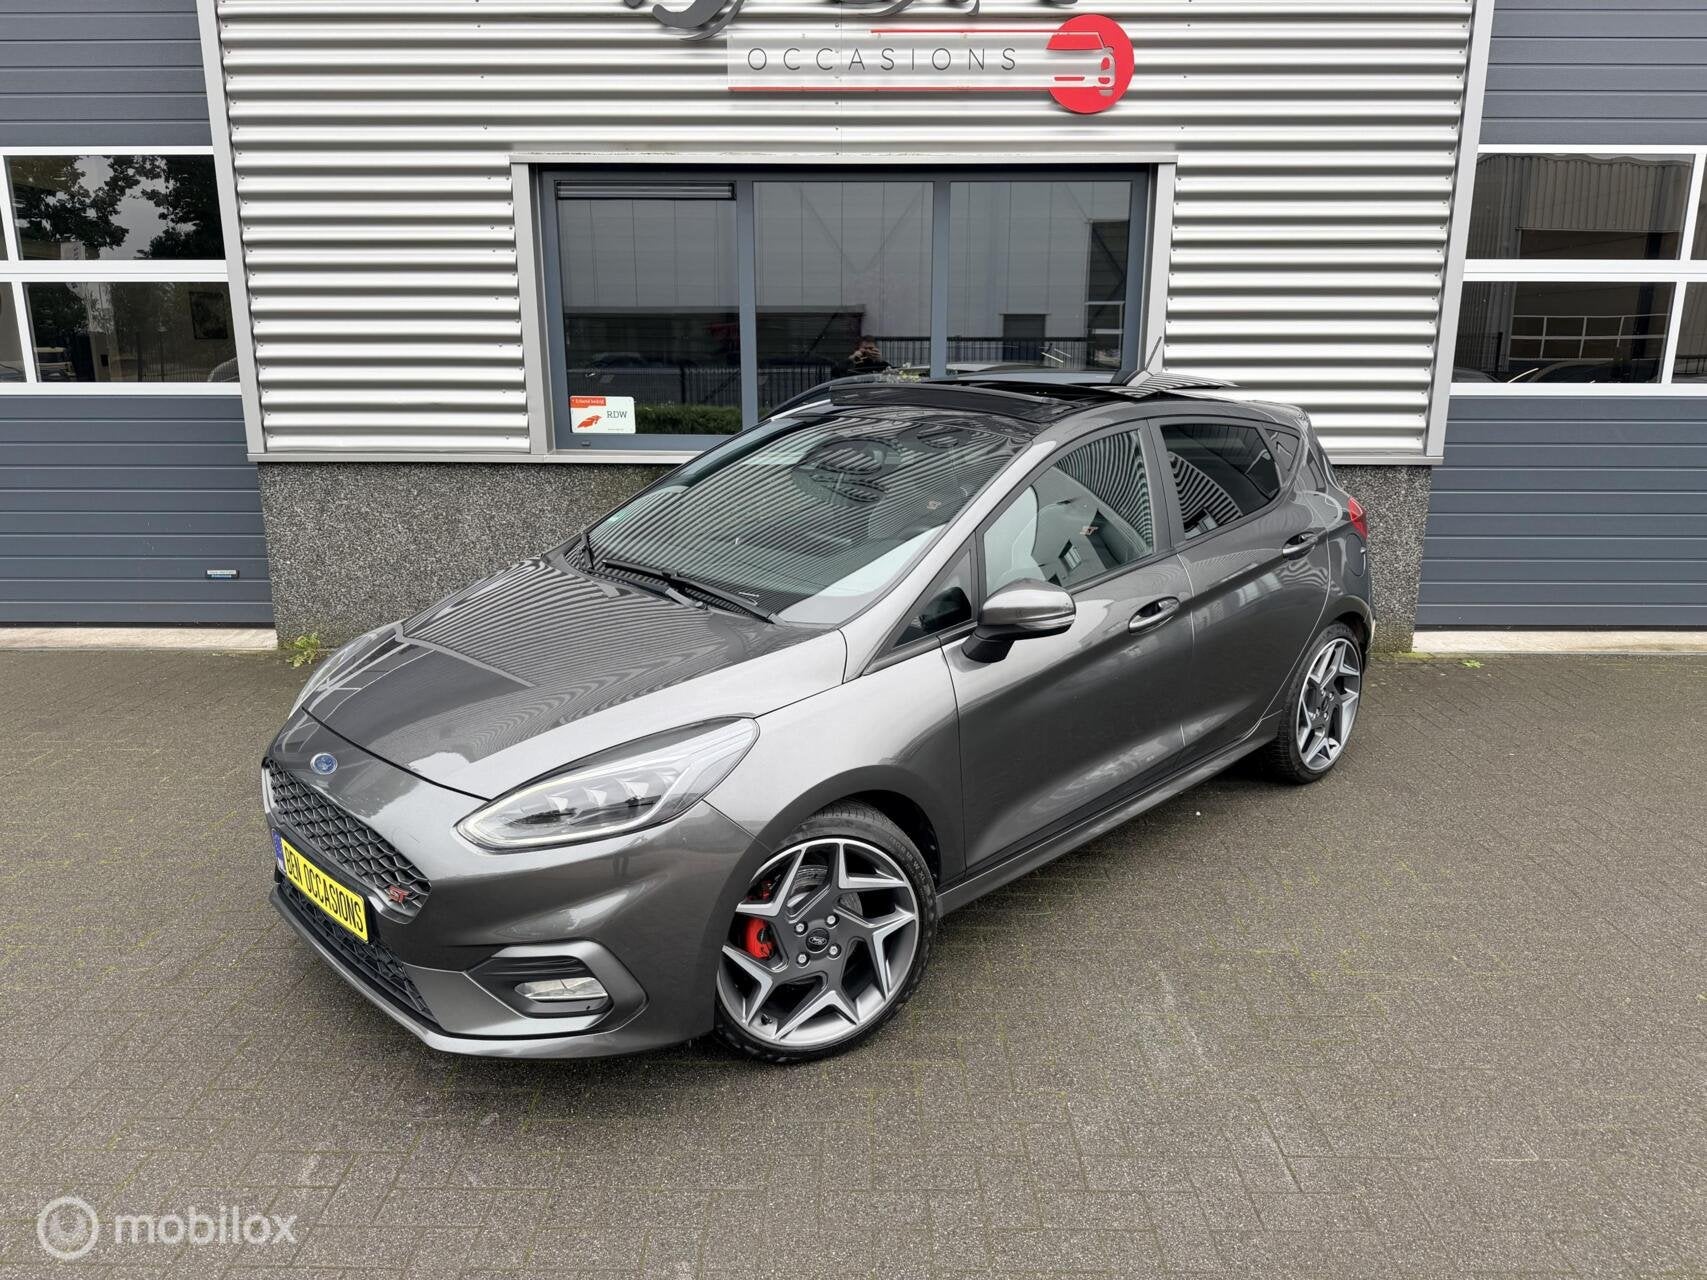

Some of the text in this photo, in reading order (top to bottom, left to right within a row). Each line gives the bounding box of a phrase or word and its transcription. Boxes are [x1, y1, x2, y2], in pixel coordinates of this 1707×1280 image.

[747, 47, 1017, 71] OCCASIONS
[606, 410, 627, 419] RDW
[284, 845, 364, 933] BEN OCCASIONS
